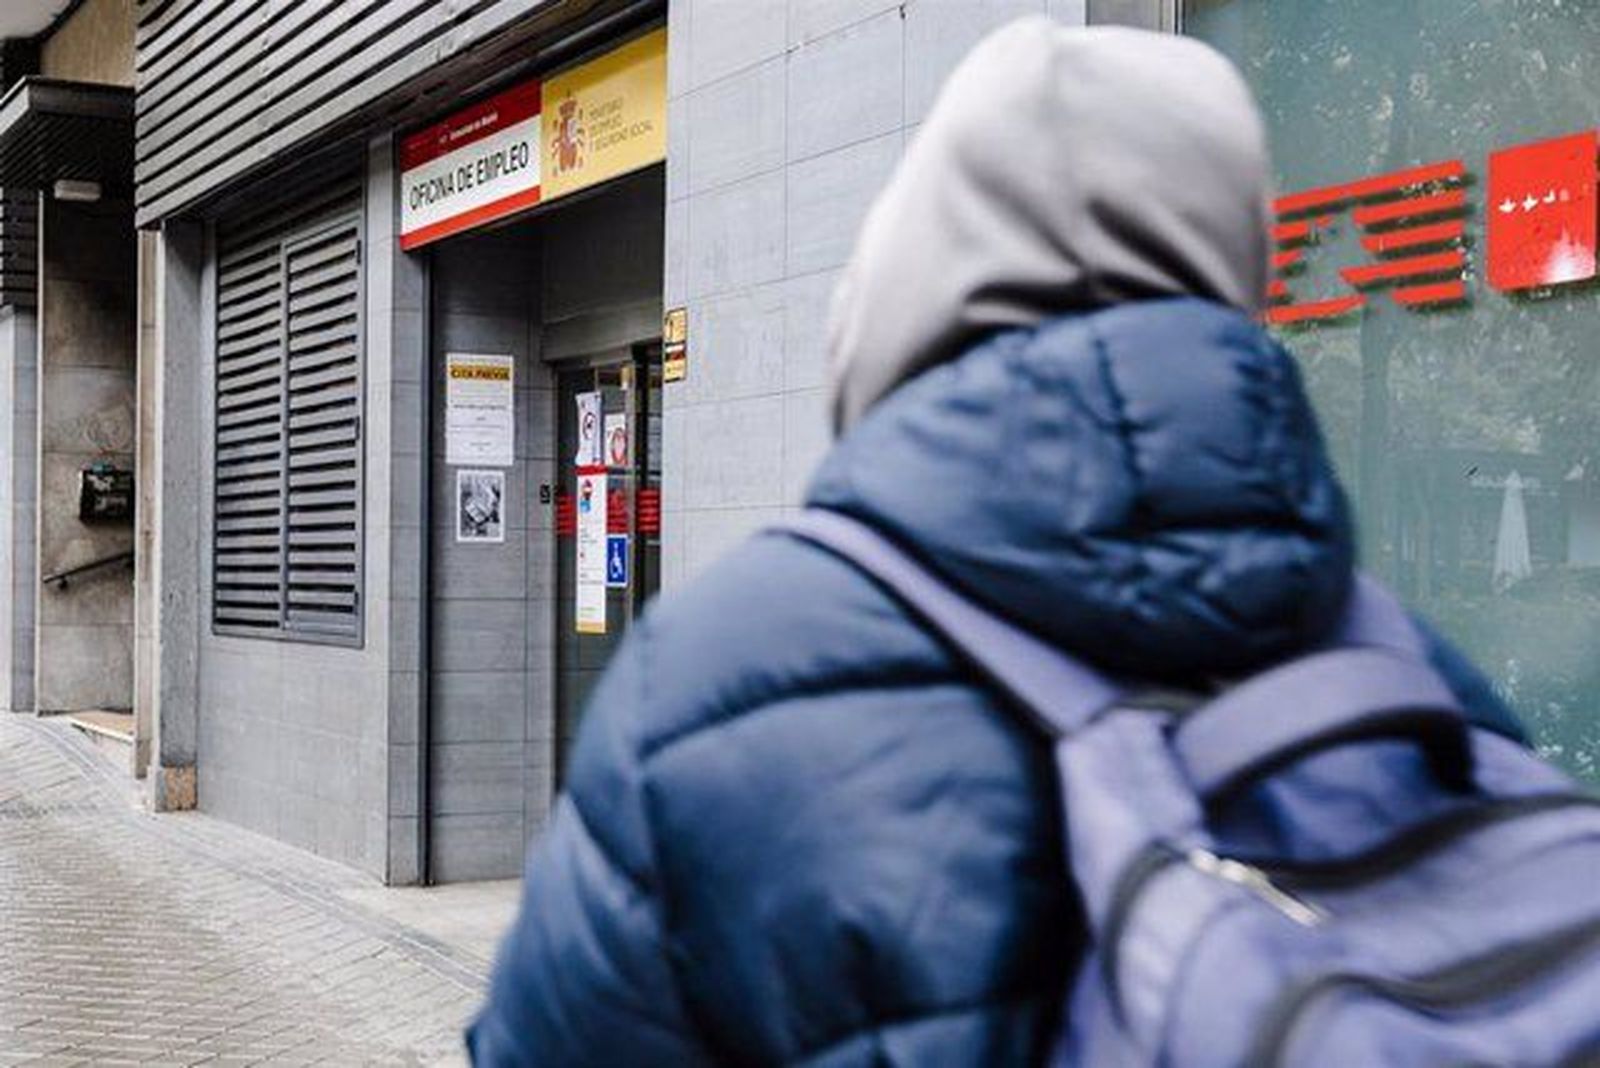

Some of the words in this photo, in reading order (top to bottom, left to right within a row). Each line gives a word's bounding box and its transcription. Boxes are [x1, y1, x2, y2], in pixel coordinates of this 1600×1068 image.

[409, 172, 455, 211] OFICINA
[456, 164, 474, 192] DE
[477, 141, 529, 185] EMPLEO
